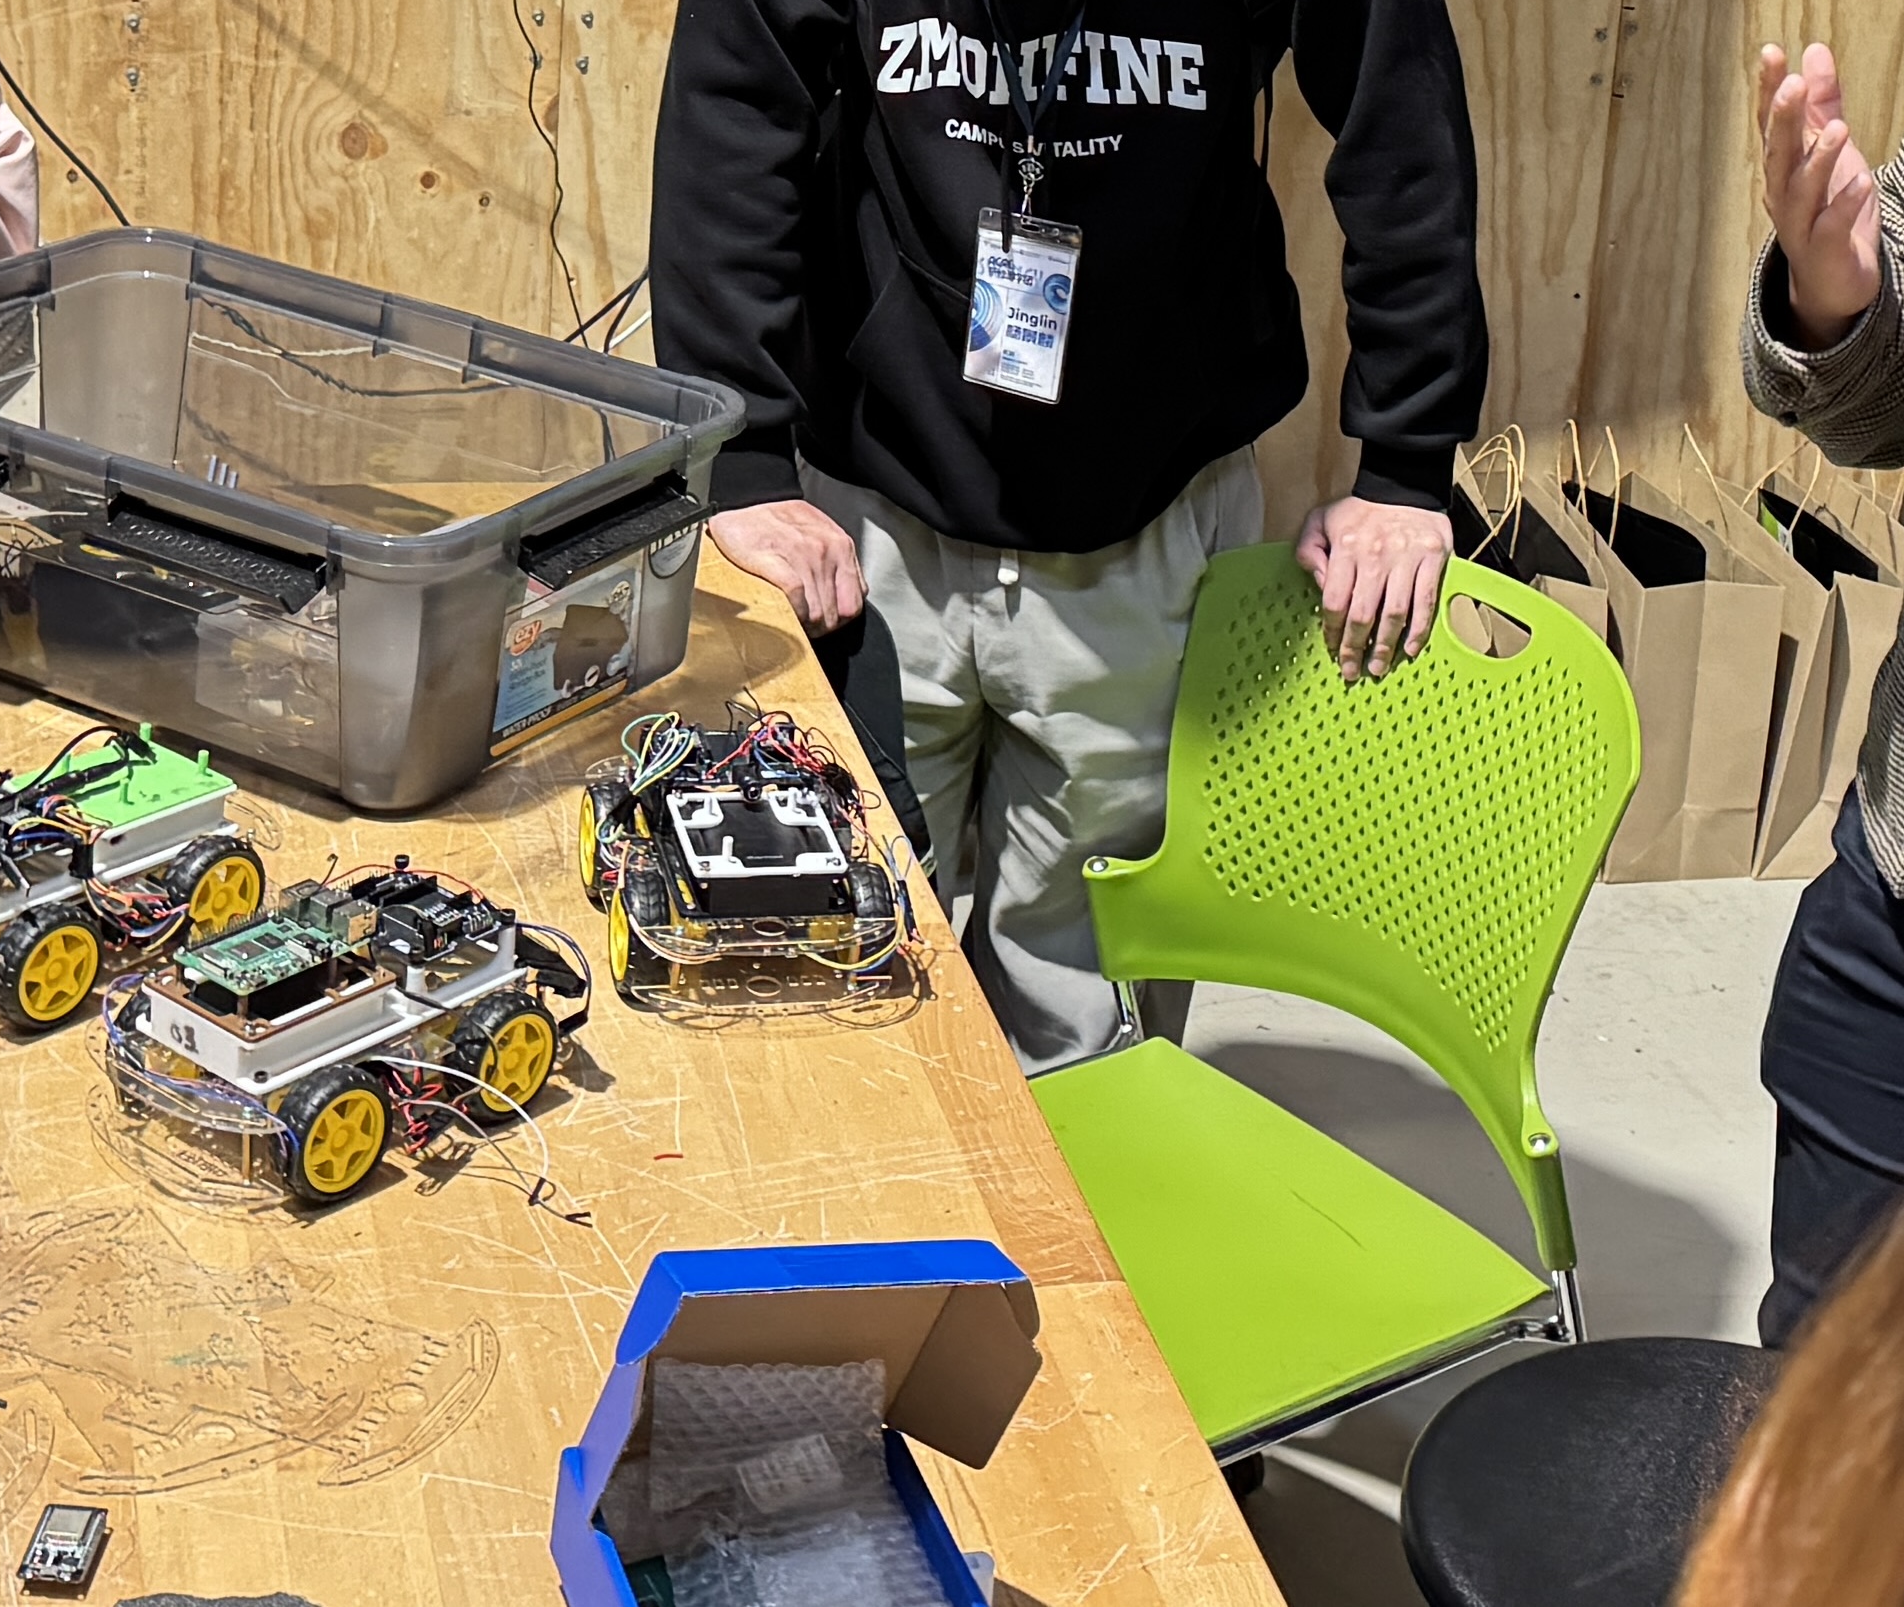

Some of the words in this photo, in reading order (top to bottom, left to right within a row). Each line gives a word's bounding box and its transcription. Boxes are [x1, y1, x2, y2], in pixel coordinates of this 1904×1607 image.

[945, 118, 1025, 154] CAMPS
[1030, 133, 1124, 158] VTALITY
[1007, 306, 1058, 331] Jinglin
[514, 620, 542, 643] ezy
